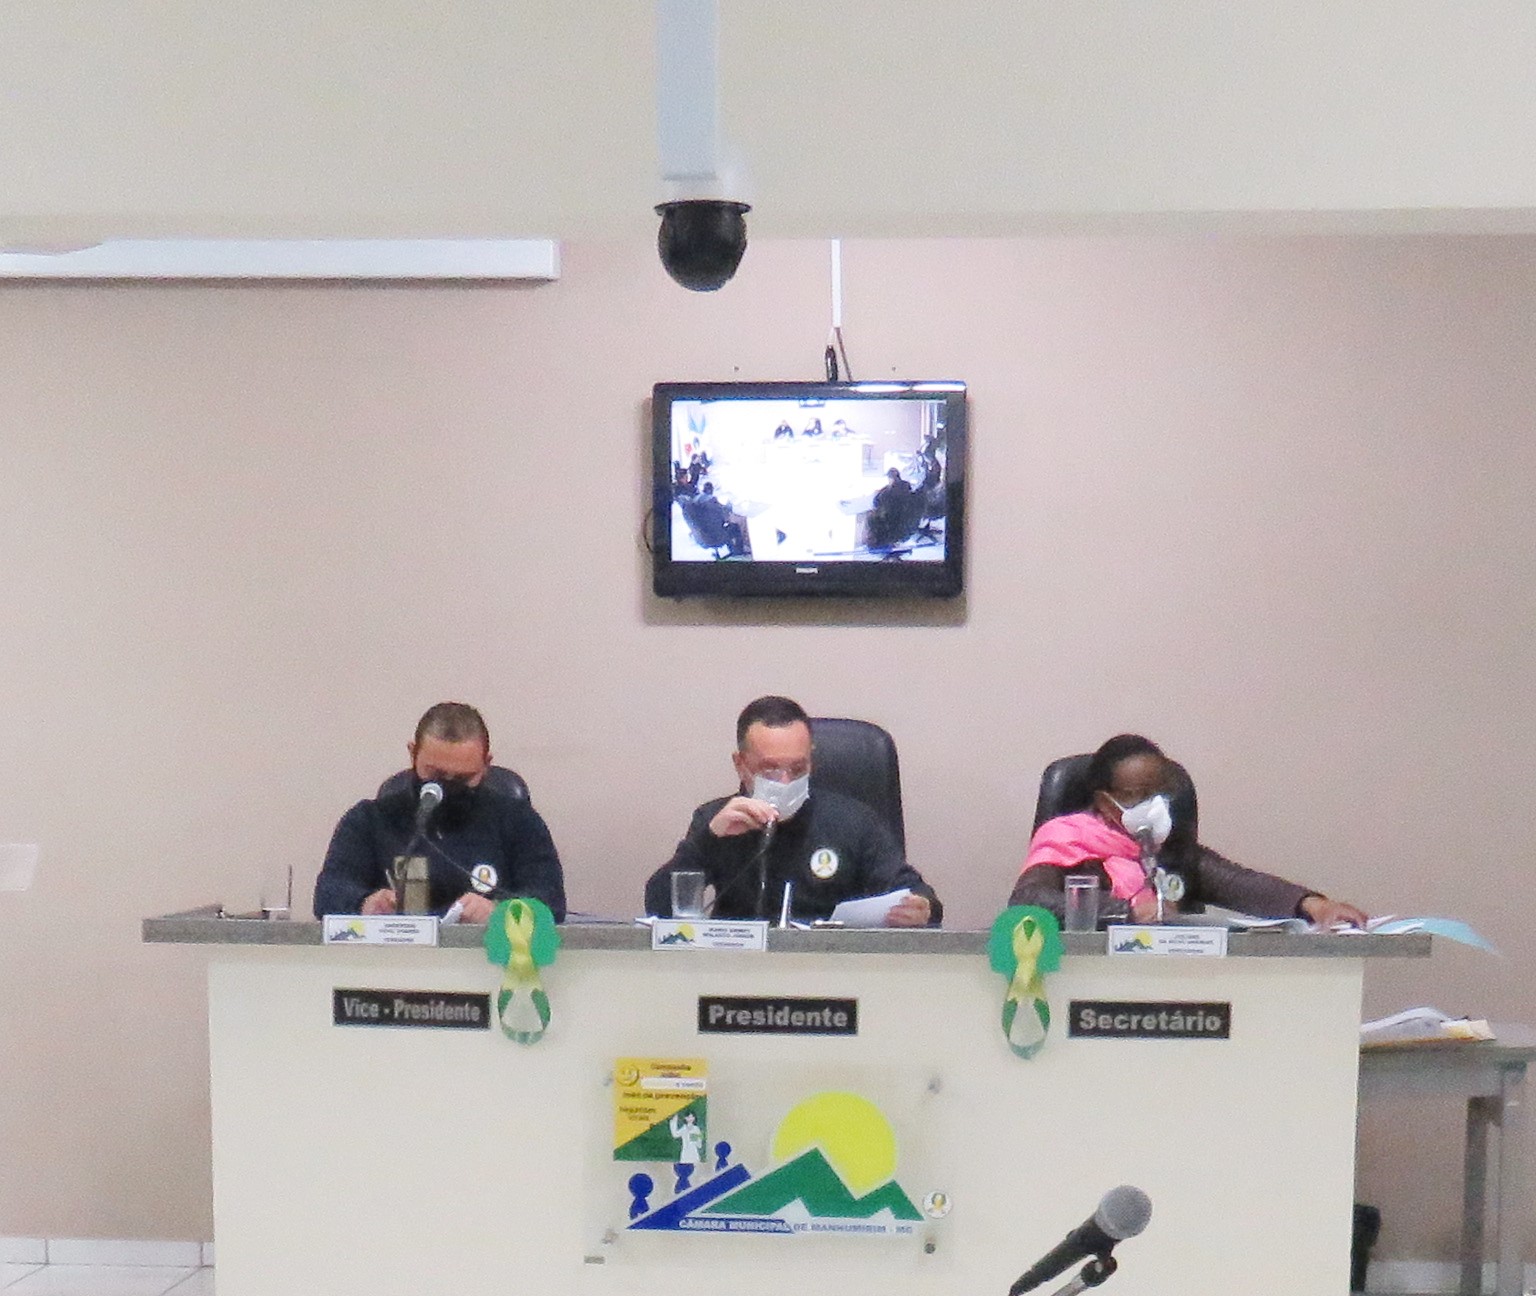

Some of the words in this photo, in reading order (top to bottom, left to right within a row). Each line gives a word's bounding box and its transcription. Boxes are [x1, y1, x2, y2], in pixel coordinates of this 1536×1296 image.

[343, 997, 379, 1018] Vice
[393, 998, 481, 1022] Presidente
[708, 1004, 849, 1027] Presidente
[1079, 1007, 1222, 1032] Secretário
[793, 1223, 808, 1231] DE
